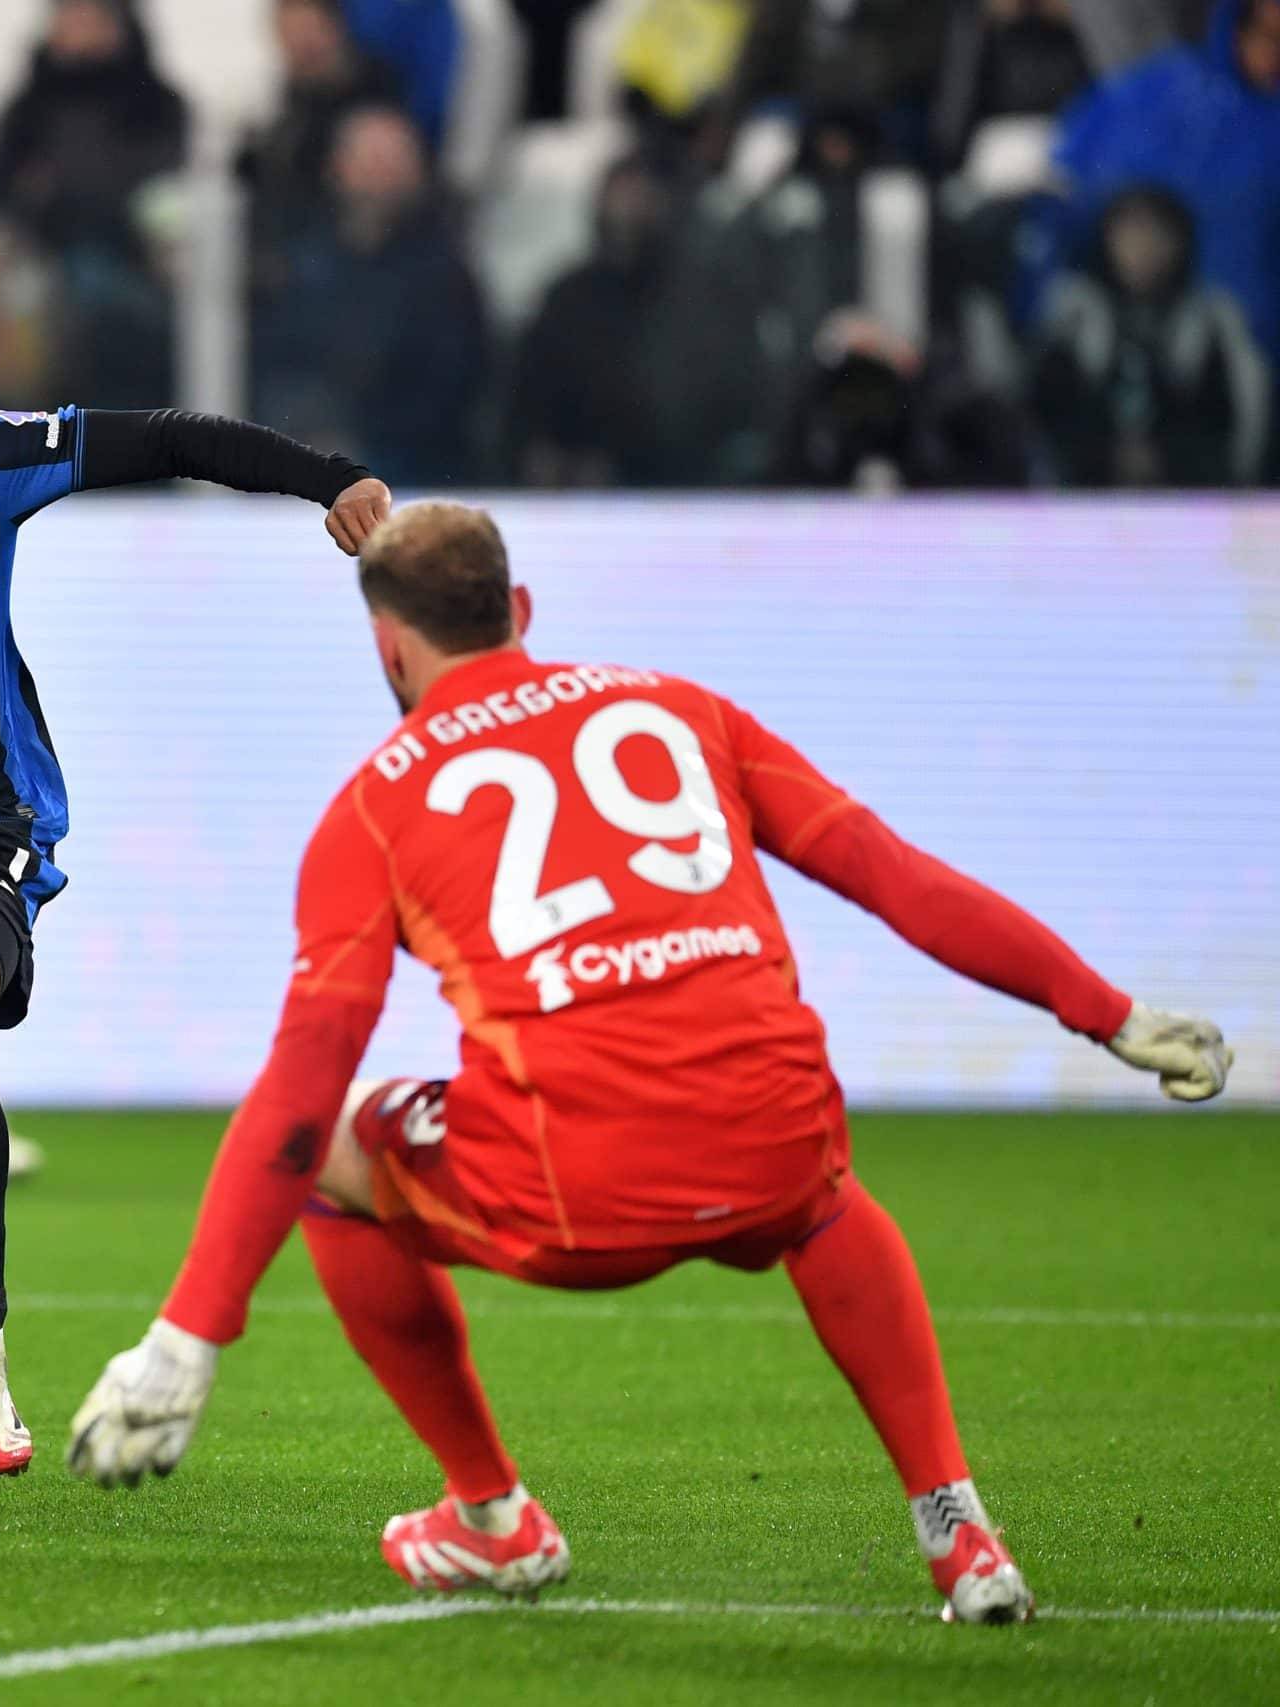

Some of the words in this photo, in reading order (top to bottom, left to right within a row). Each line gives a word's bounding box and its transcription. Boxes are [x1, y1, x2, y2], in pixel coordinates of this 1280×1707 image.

[374, 733, 427, 782] DI
[425, 699, 733, 960] 29
[570, 924, 762, 985] Cygames
